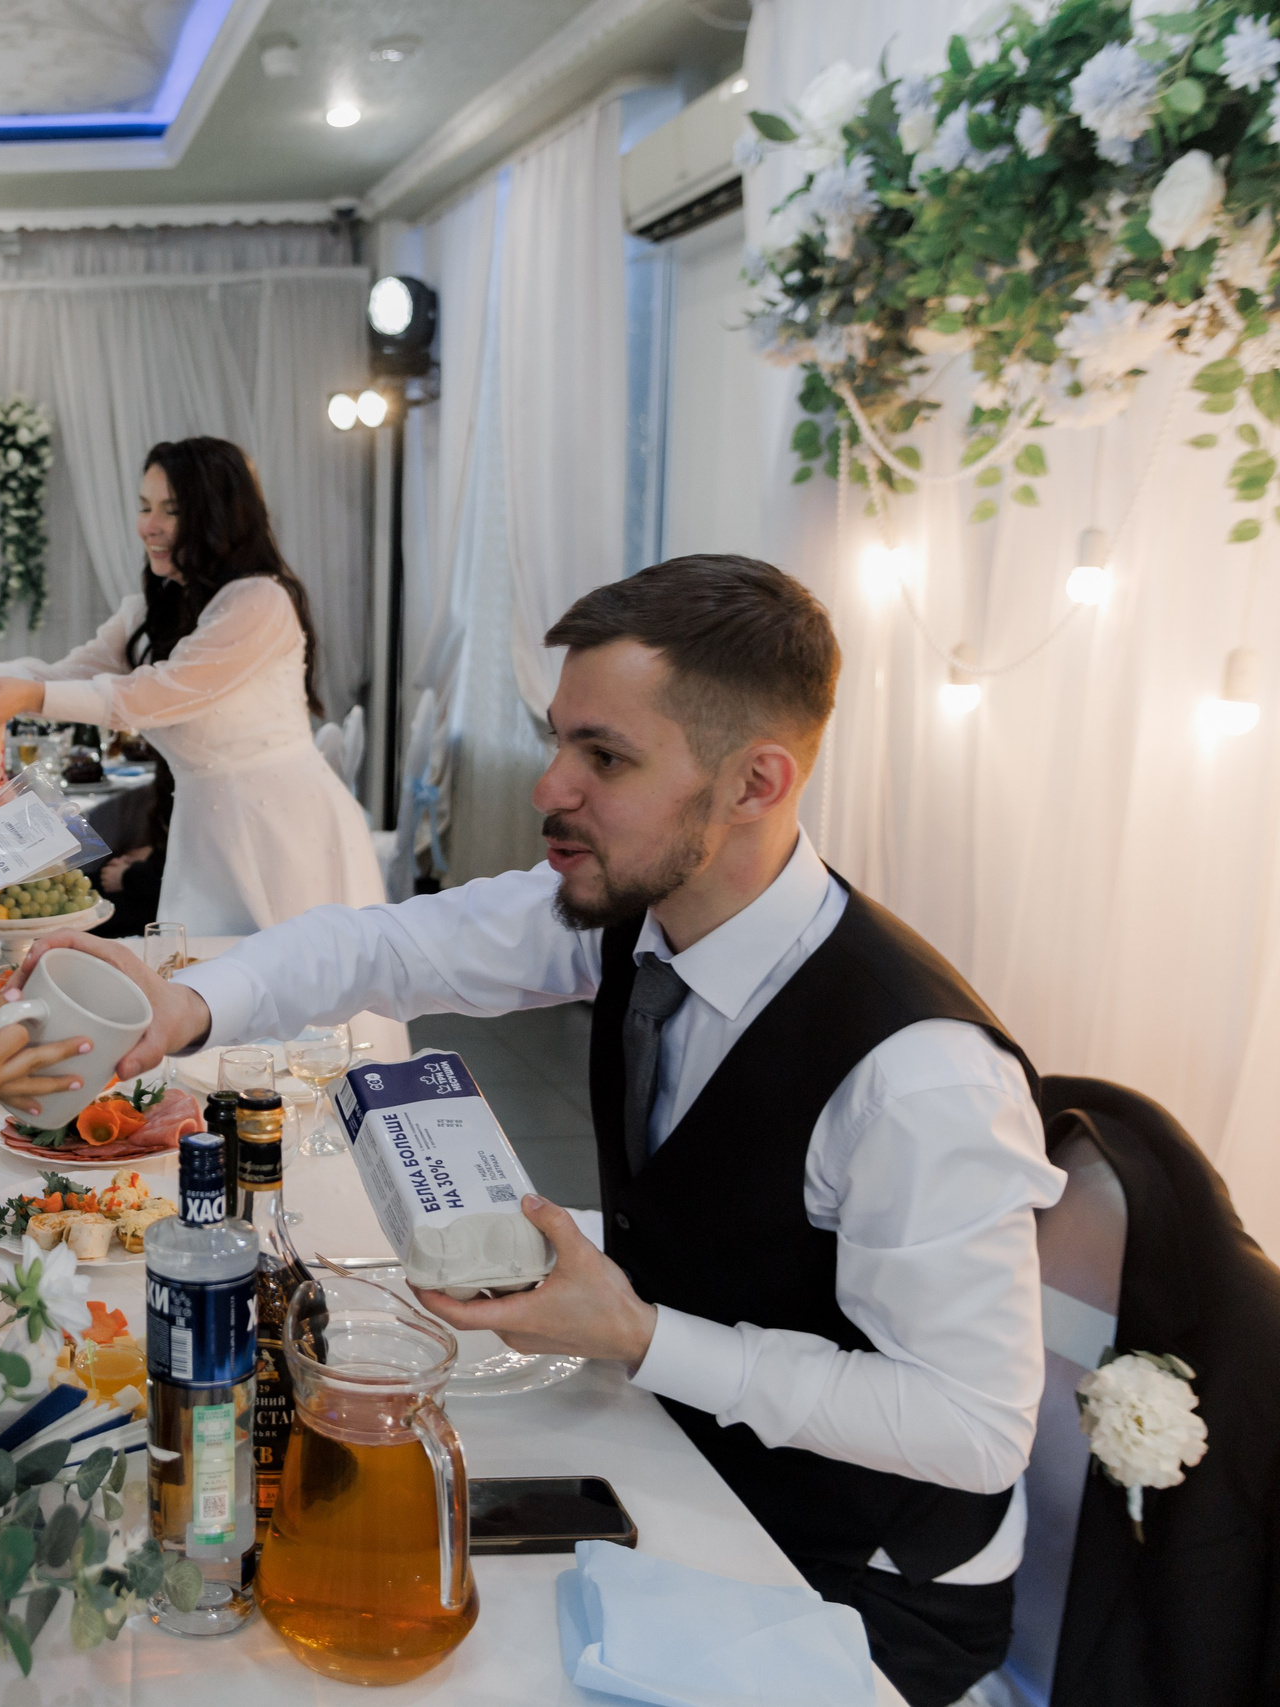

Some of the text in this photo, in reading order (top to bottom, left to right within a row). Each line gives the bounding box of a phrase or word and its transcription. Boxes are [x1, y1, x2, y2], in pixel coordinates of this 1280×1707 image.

[435, 1072, 448, 1084] ТРИ
[440, 1060, 463, 1091] НЕСУШКИ
[382, 1113, 420, 1168] БОЛЬШЕ
[409, 1169, 442, 1213] БЕЛКА
[442, 1188, 464, 1209] НА
